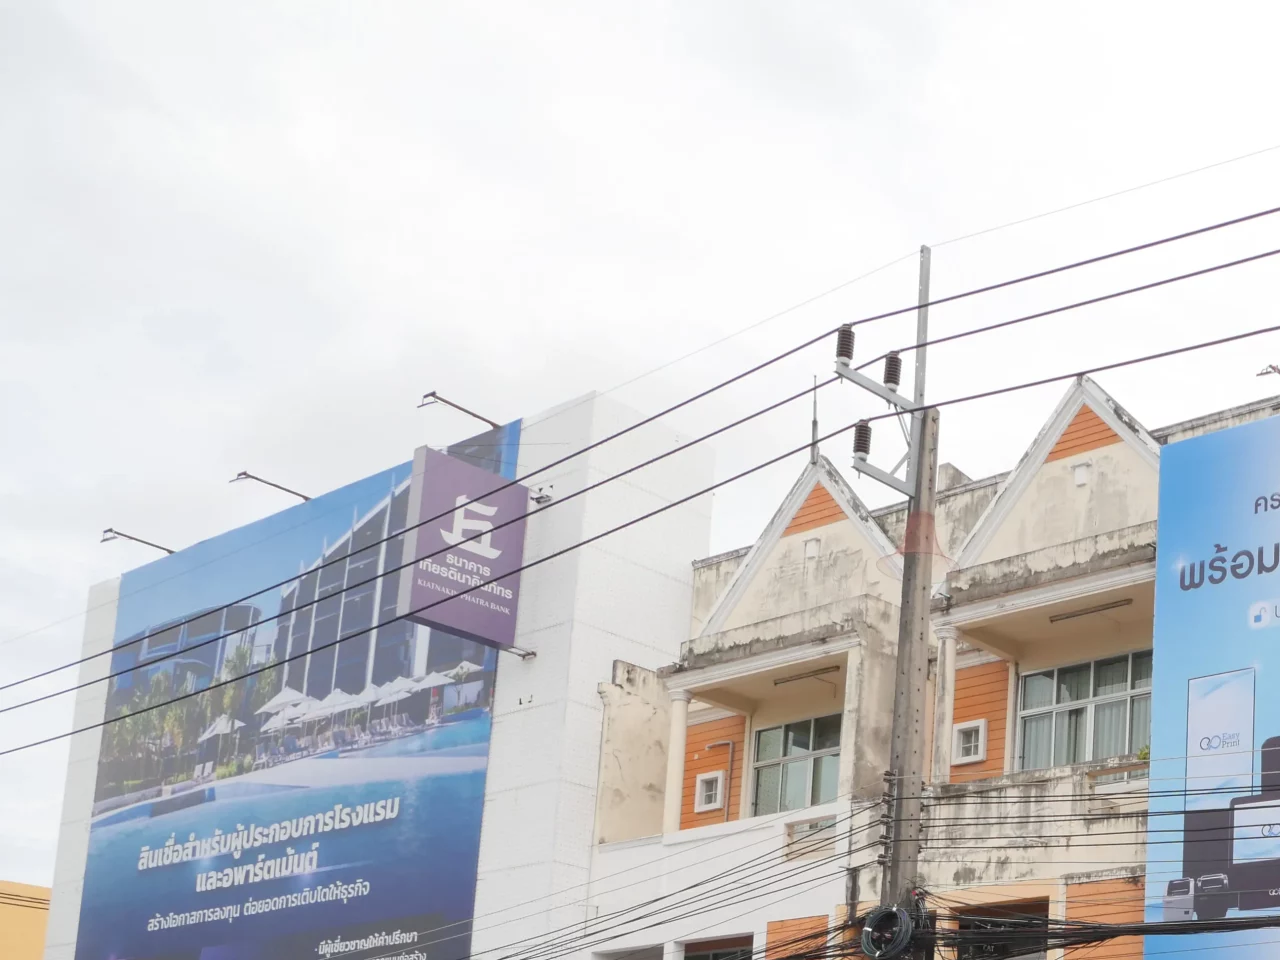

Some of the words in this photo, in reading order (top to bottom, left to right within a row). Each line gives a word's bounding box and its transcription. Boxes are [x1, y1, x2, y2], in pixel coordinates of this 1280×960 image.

[419, 558, 513, 599] เกียรตินาคินภัทร
[446, 554, 491, 577] ธนาคาร
[490, 602, 511, 615] BANK
[1221, 740, 1240, 749] Print
[1222, 732, 1240, 742] Easy
[137, 797, 400, 871] สินเชื่อสำหรับผู้ประกอบการโรงแรม
[196, 842, 320, 892] และอพาร์ตเม้นต์
[147, 903, 241, 932] สร้างโอกาสการลงทุน
[243, 878, 371, 917] ต่อยอดการเติบโตให้ธุรกิจ
